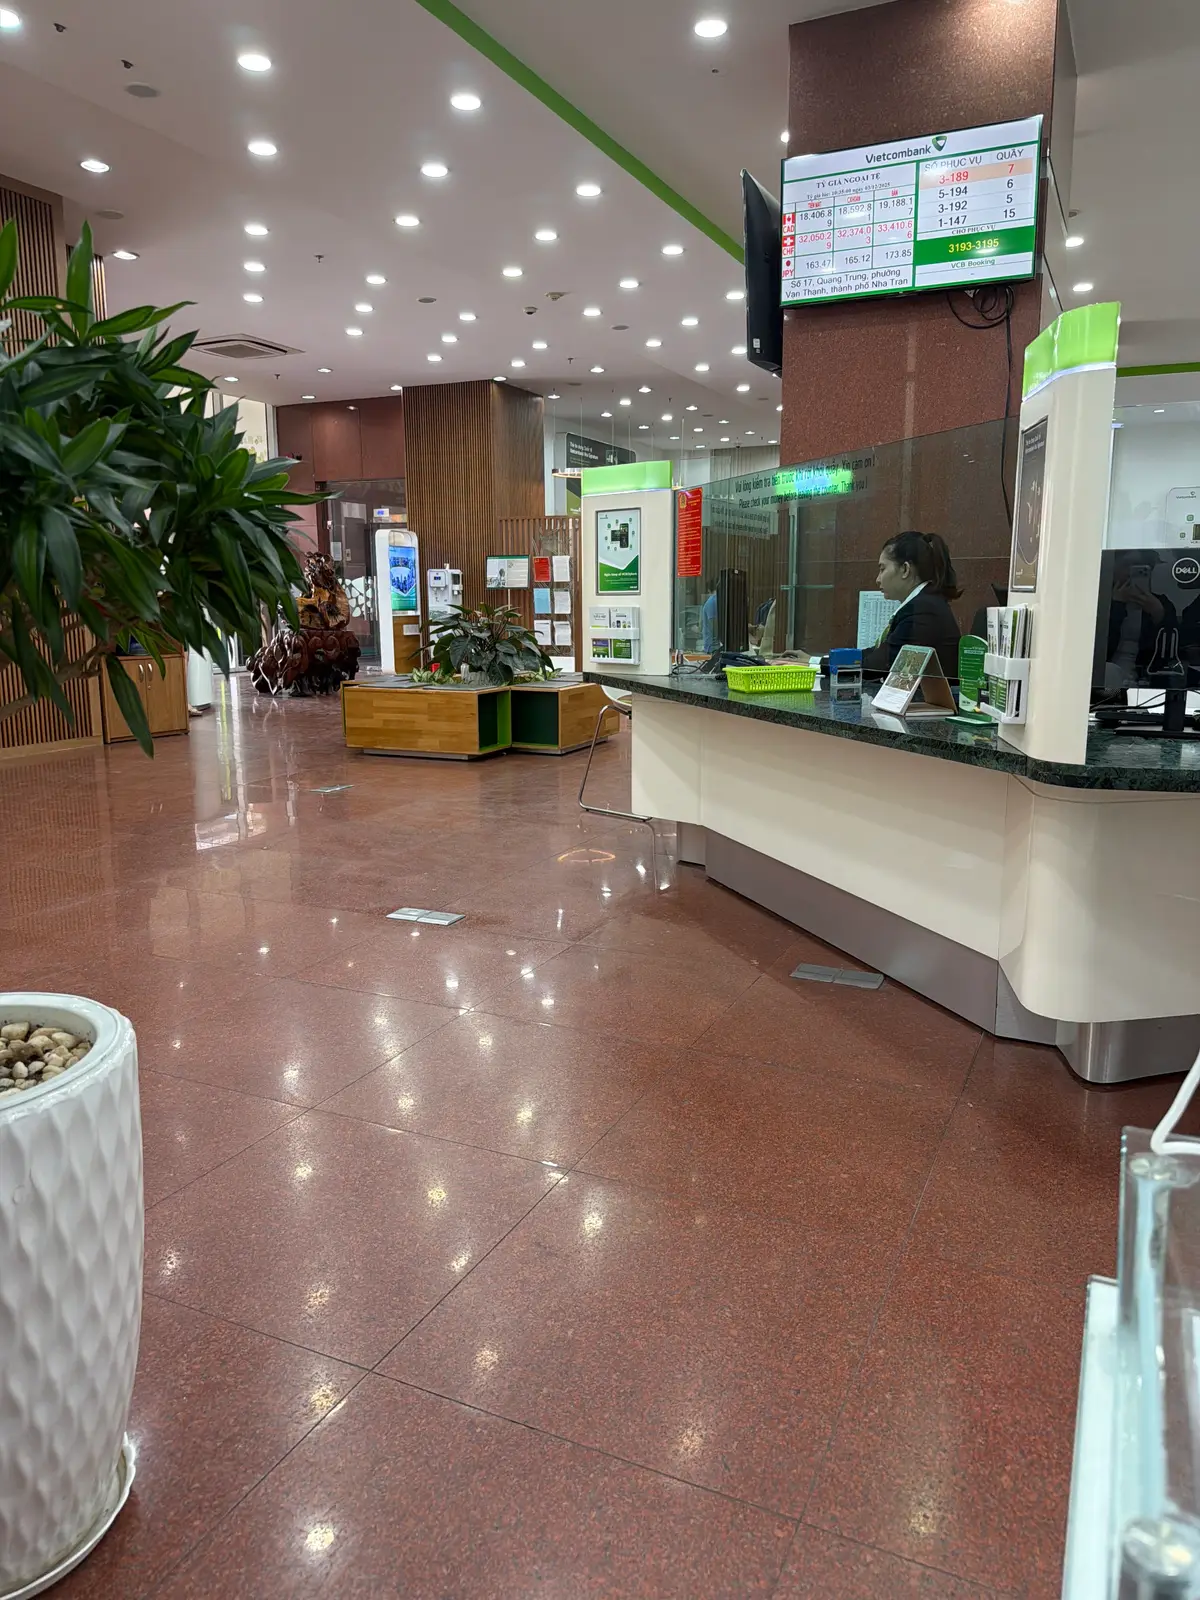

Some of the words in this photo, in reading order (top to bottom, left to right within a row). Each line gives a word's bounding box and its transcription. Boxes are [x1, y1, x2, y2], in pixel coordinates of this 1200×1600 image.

[865, 145, 932, 164] Vietcombank
[1008, 164, 1015, 174] 7
[939, 170, 969, 185] 3-189
[1007, 179, 1014, 188] 6
[938, 186, 968, 199] 5-194
[879, 197, 913, 209] 19,188.1
[1006, 194, 1013, 203] 5
[839, 203, 872, 216] 18,592.8
[908, 208, 913, 216] 7
[938, 200, 968, 214] 3-192
[799, 209, 832, 221] 18,406.8
[1003, 208, 1016, 219] 15
[827, 219, 832, 227] 9
[878, 220, 913, 232] 33,410.6
[939, 215, 967, 228] 1-147
[783, 225, 794, 233] CAD
[837, 226, 872, 238] 32,374.0
[799, 232, 832, 243] 32,050.2
[948, 238, 999, 253] 3193-3195
[782, 247, 794, 256] CHF
[885, 249, 912, 259] 173.85
[806, 260, 831, 269] 163.47
[845, 254, 870, 264] 165.12
[951, 260, 966, 269] VCB
[968, 259, 995, 268] Booking
[782, 269, 794, 278] JPY
[804, 279, 814, 287] 17,
[817, 276, 842, 285] Quang
[845, 273, 869, 283] Trung,
[831, 283, 852, 293] thành
[872, 279, 887, 288] Nha
[890, 278, 908, 286] Tran
[739, 498, 750, 508] Please
